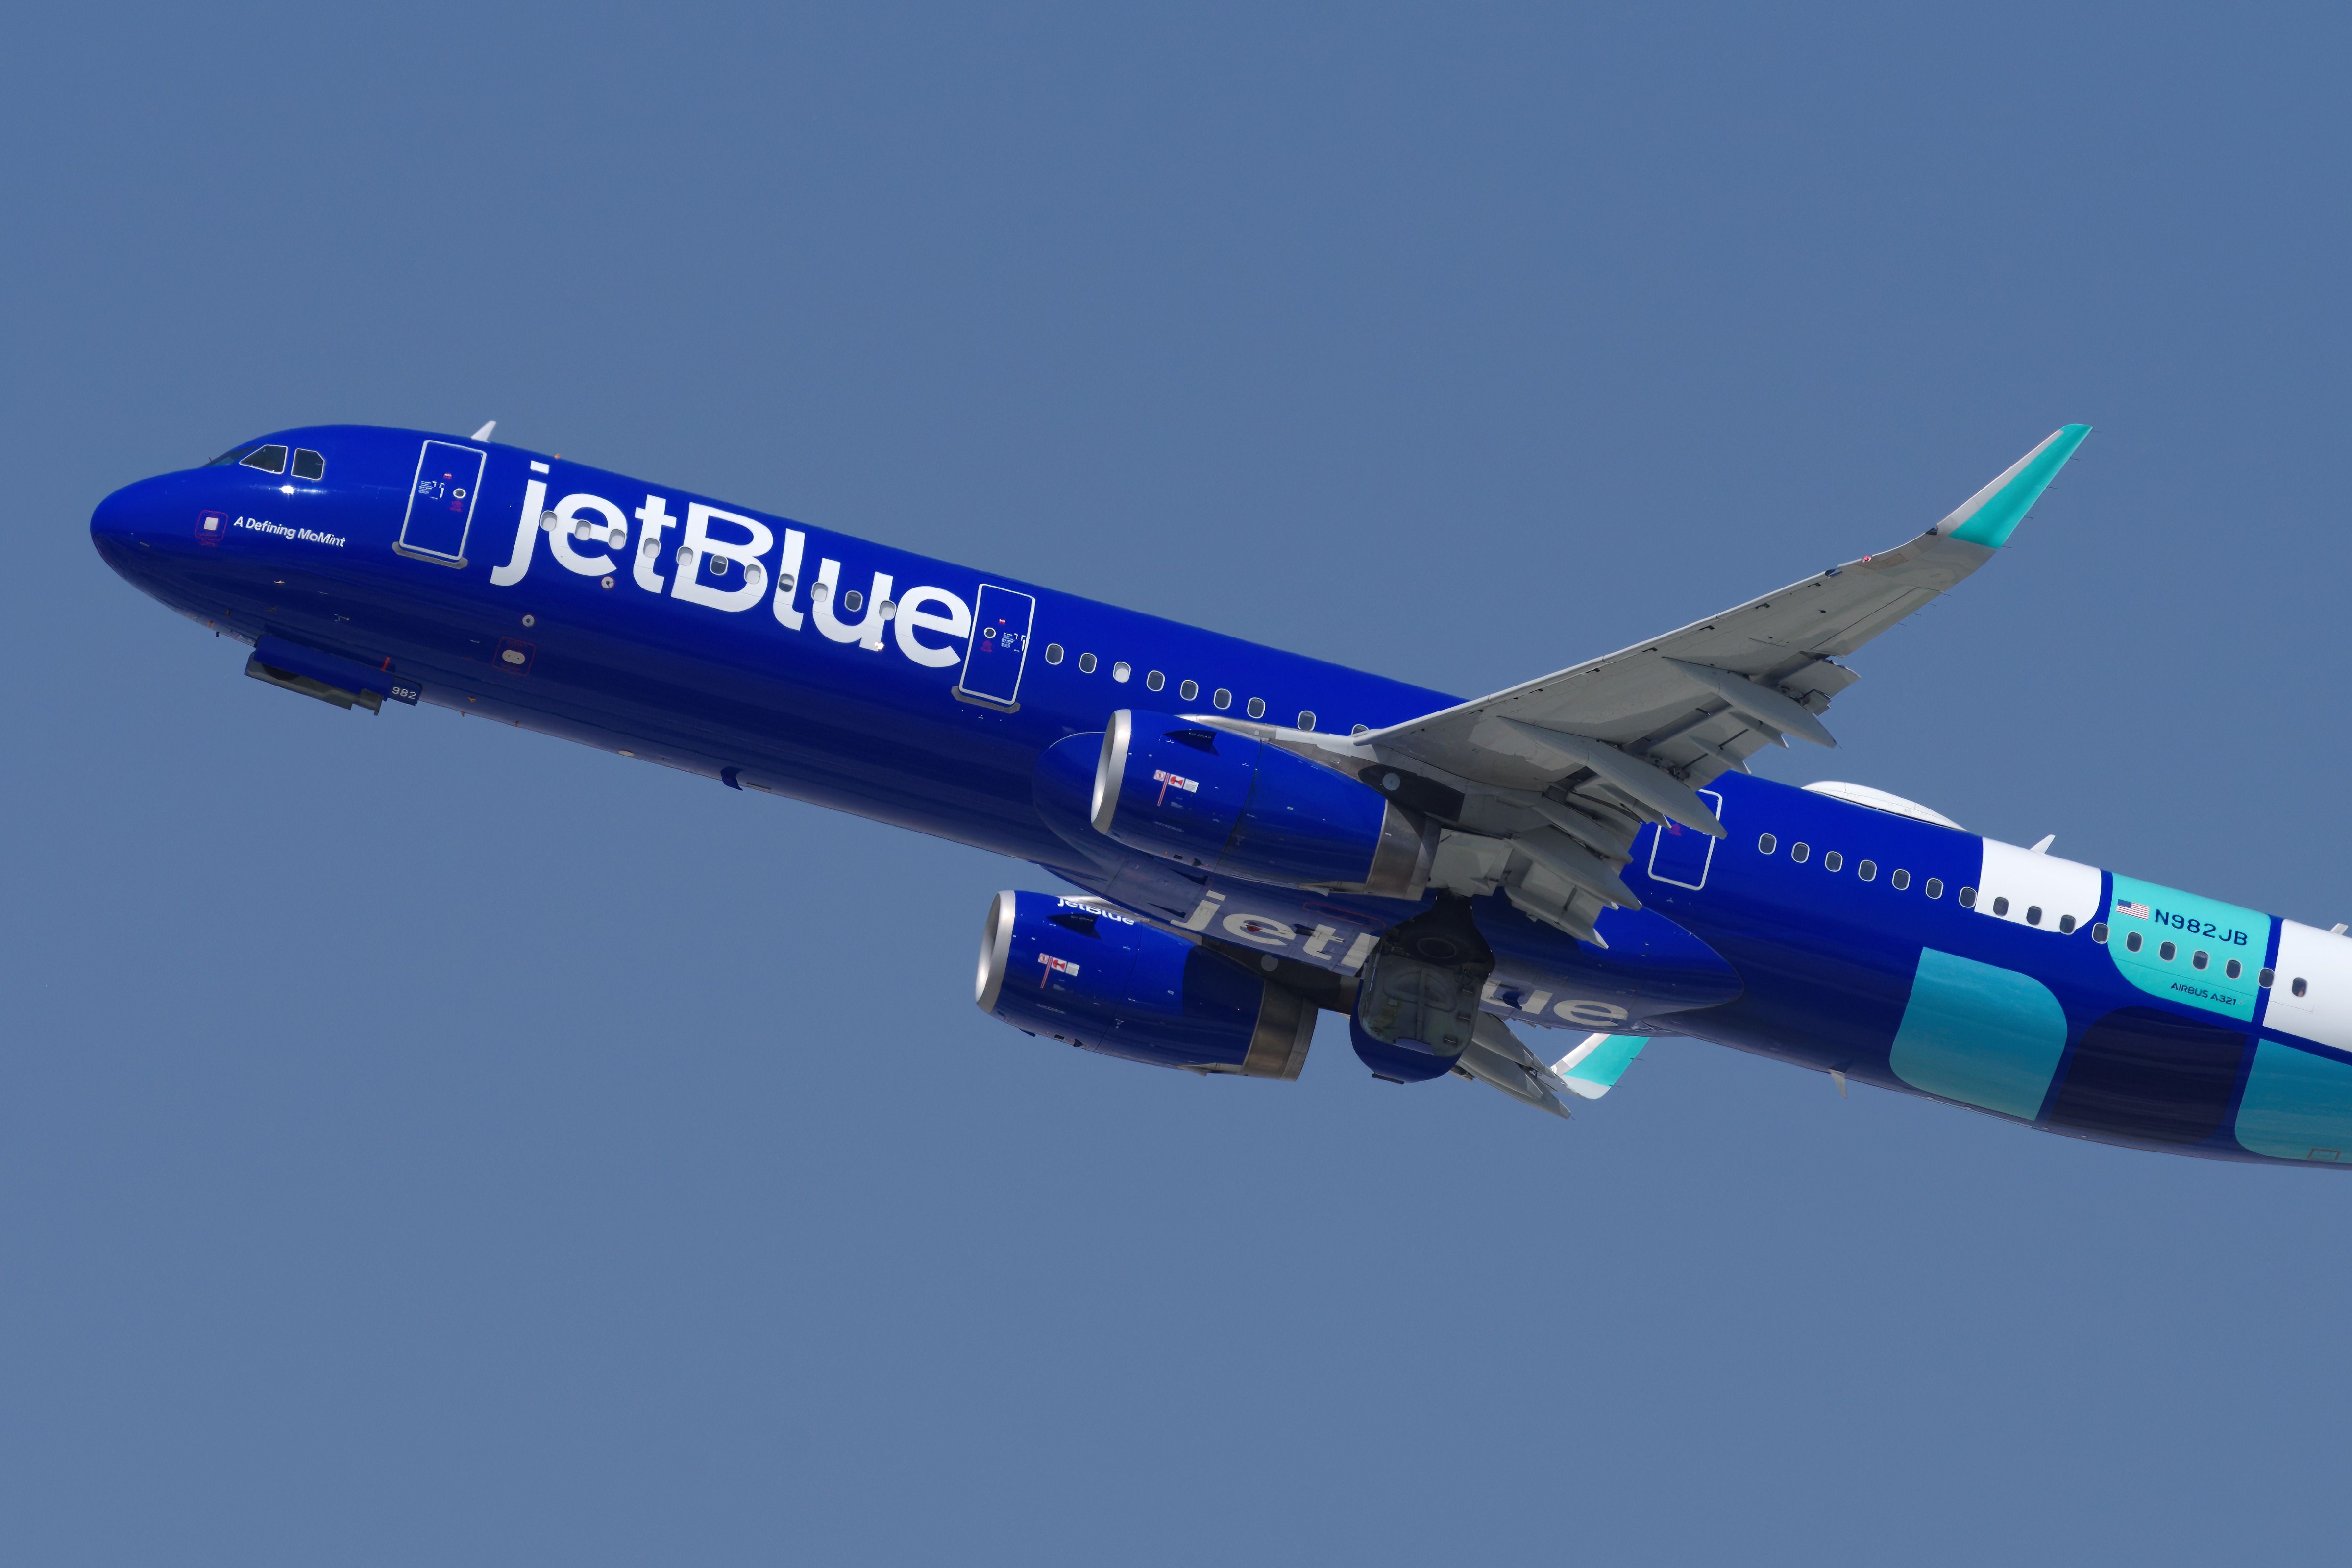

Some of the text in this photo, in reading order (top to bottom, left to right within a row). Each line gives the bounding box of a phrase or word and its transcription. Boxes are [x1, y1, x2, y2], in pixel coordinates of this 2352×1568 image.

[233, 516, 345, 547] A Defining MoMint
[490, 460, 971, 668] jetBlue
[392, 687, 416, 699] 982
[2155, 909, 2248, 946] N982JB
[2170, 982, 2236, 1006] AIRBUS A321
